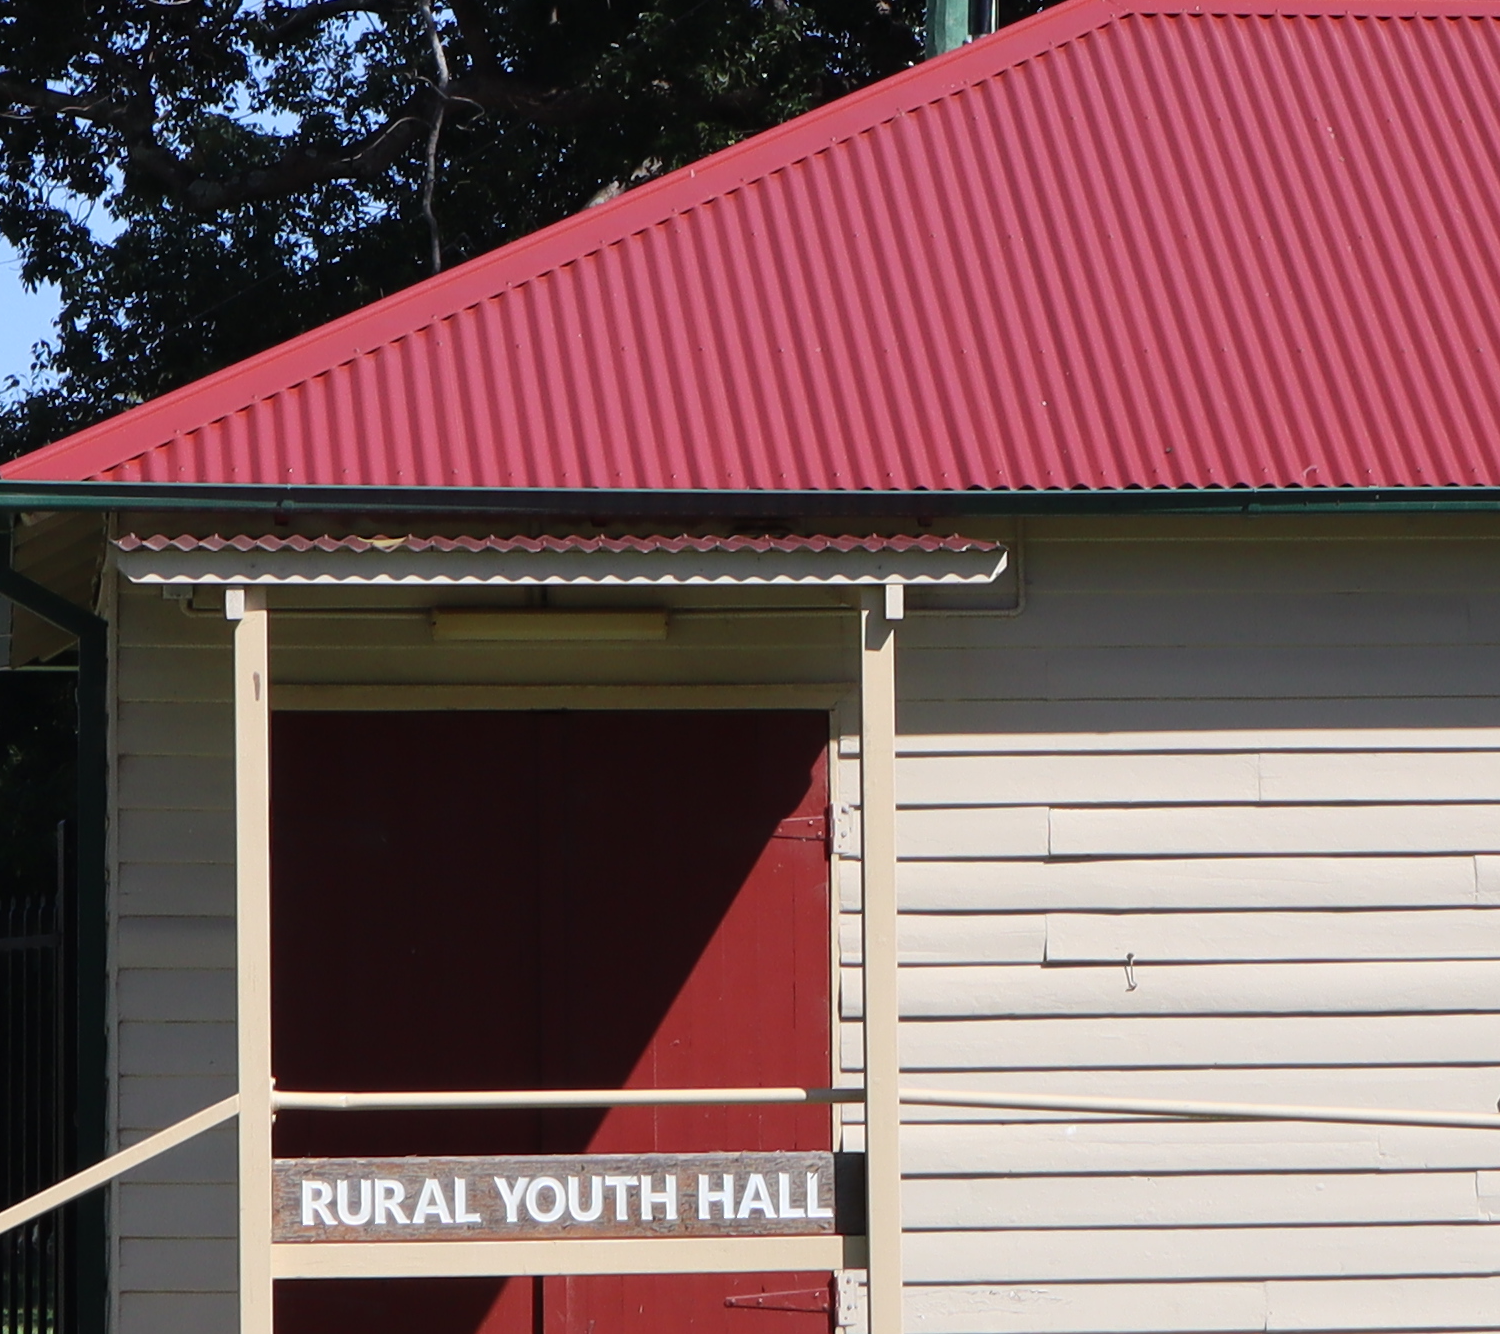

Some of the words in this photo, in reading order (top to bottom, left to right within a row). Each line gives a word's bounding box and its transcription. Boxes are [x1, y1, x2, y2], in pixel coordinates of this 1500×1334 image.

[302, 1176, 482, 1226] RURAL
[493, 1173, 678, 1223] YOUTH
[698, 1171, 834, 1220] HALL
